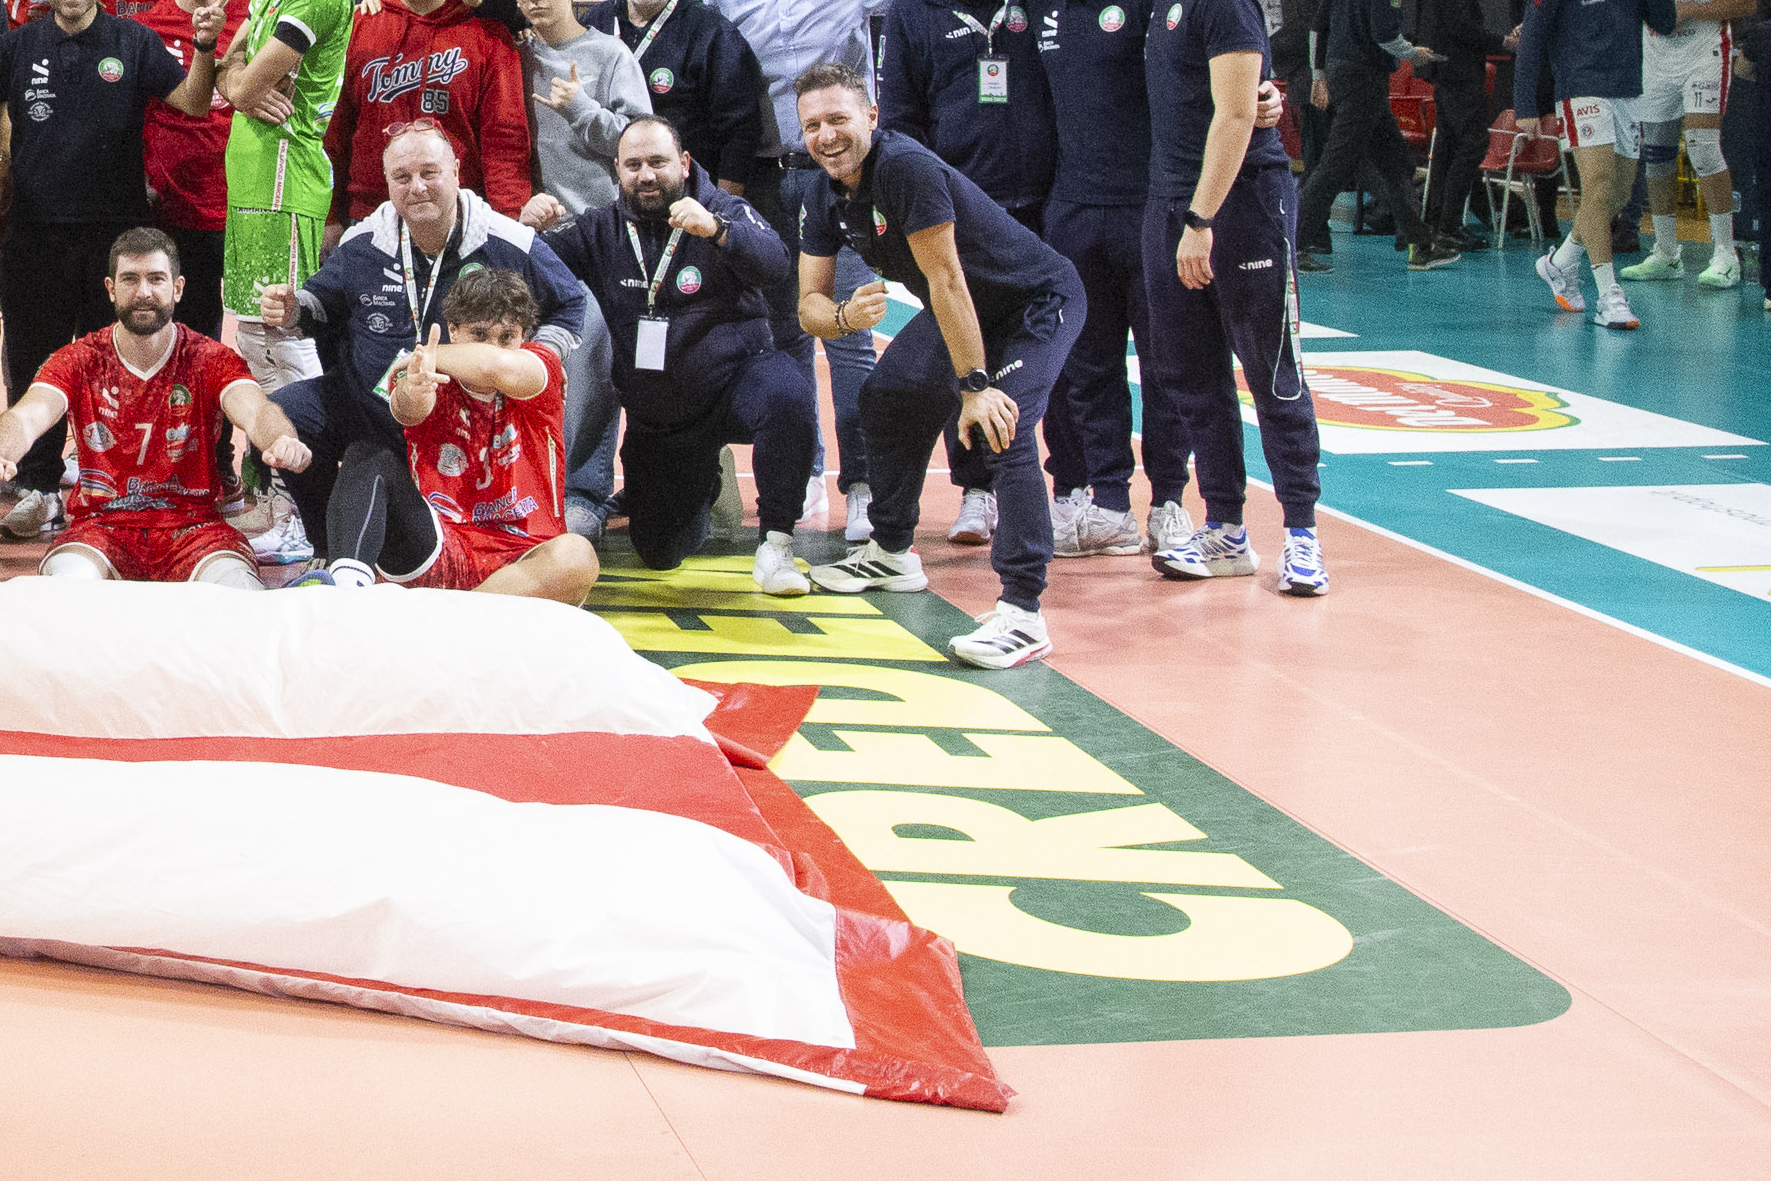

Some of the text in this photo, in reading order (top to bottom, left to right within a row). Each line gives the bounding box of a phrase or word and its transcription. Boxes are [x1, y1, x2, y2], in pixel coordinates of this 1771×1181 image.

[116, 0, 156, 17] BANC
[31, 76, 49, 85] nine
[362, 46, 468, 103] Tommy
[421, 89, 449, 115] 85
[1576, 104, 1601, 117] AVIS
[1247, 258, 1273, 270] nine
[382, 284, 403, 293] nine
[134, 422, 153, 466] 7
